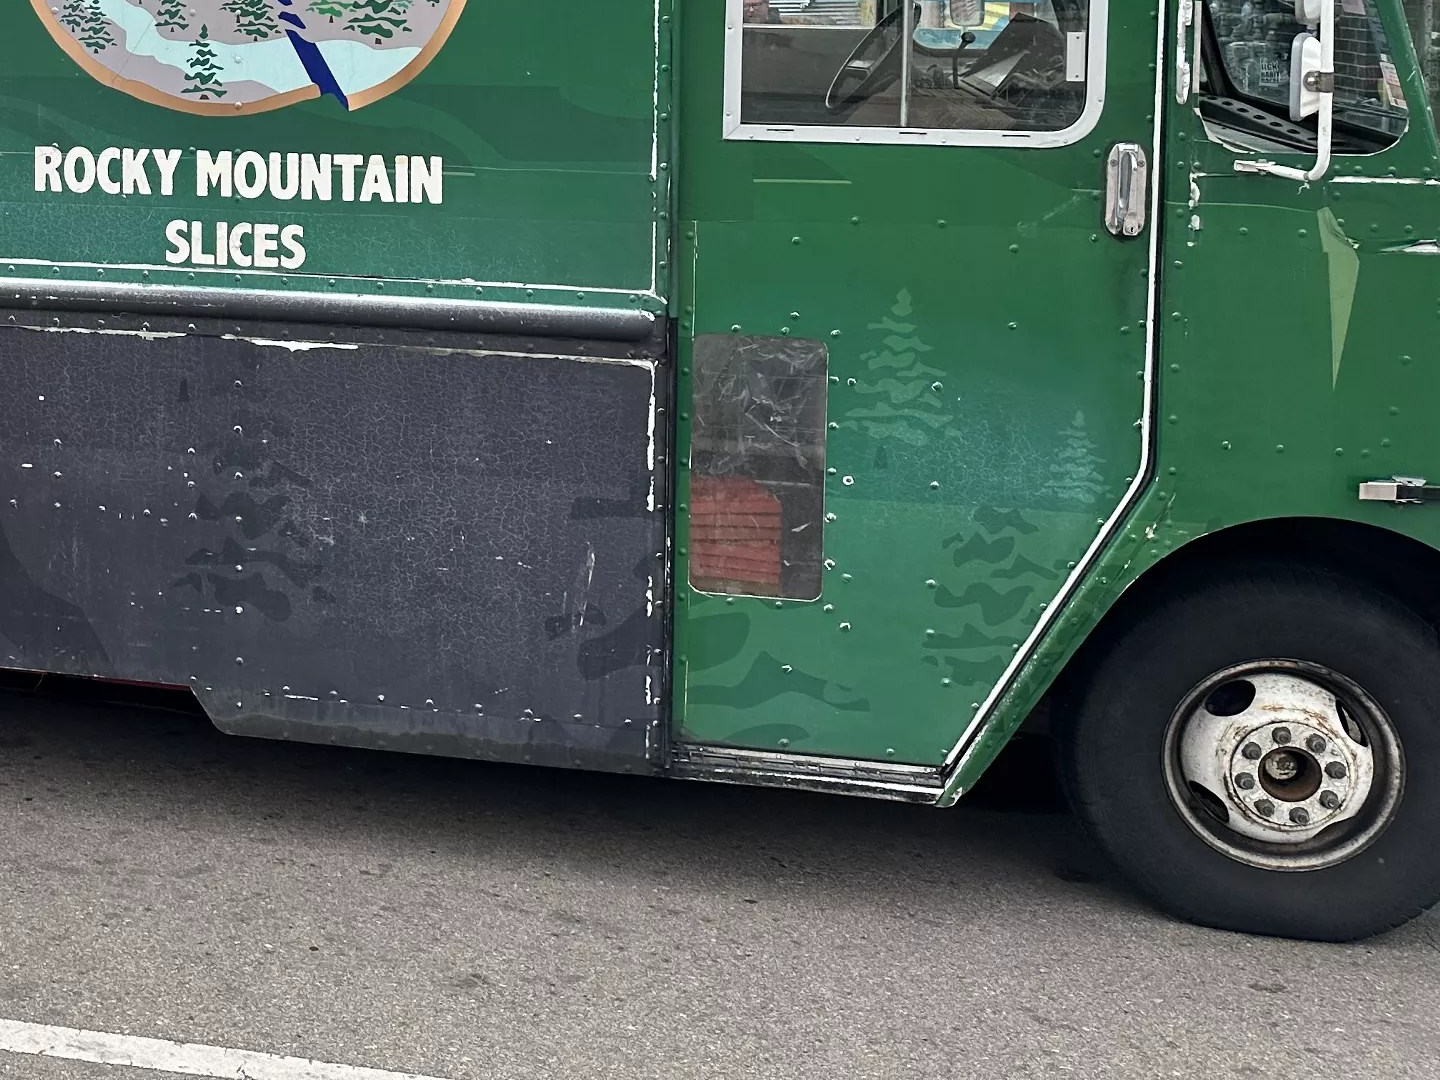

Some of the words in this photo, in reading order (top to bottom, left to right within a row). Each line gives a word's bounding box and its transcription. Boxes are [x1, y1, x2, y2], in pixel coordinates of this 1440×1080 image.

[33, 145, 183, 197] ROCKY
[195, 149, 444, 205] MOUNTAIN
[165, 219, 307, 270] SLICES
